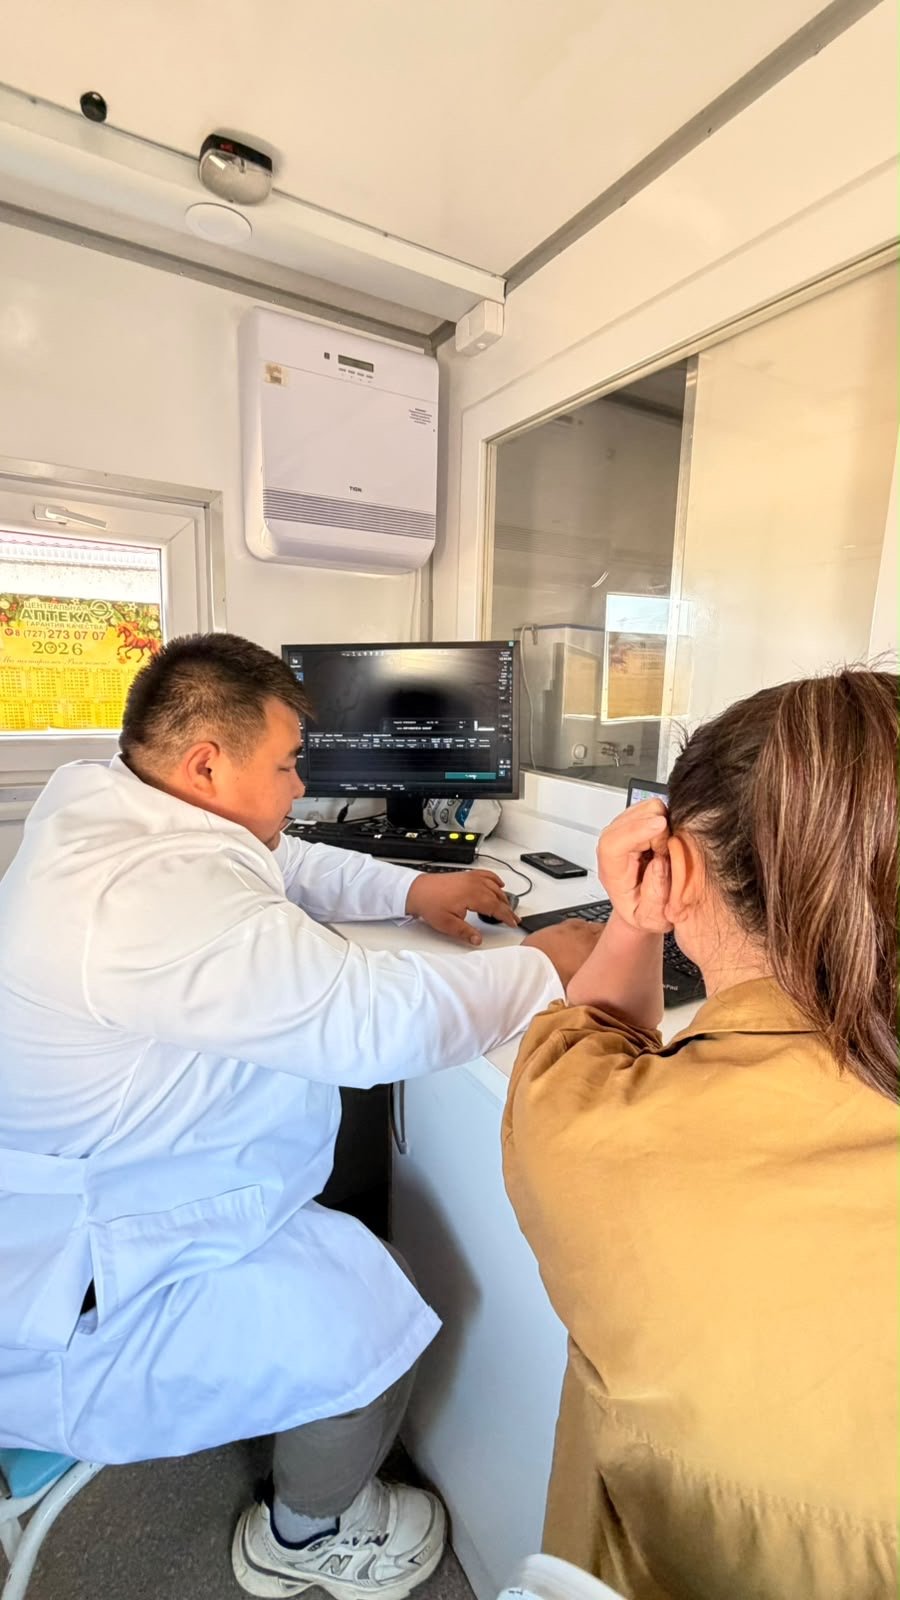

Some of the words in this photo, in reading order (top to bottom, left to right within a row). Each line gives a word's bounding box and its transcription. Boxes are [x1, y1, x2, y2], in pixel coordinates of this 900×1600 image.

[24, 601, 88, 611] ЦЕНТРАЛЬНАЯ
[21, 609, 93, 623] АПТЕКА
[23, 629, 46, 639] (727)
[47, 629, 70, 640] 273
[73, 631, 88, 640] 07
[92, 631, 106, 641] 07
[31, 640, 83, 656] 2026
[318, 1554, 353, 1577] N
